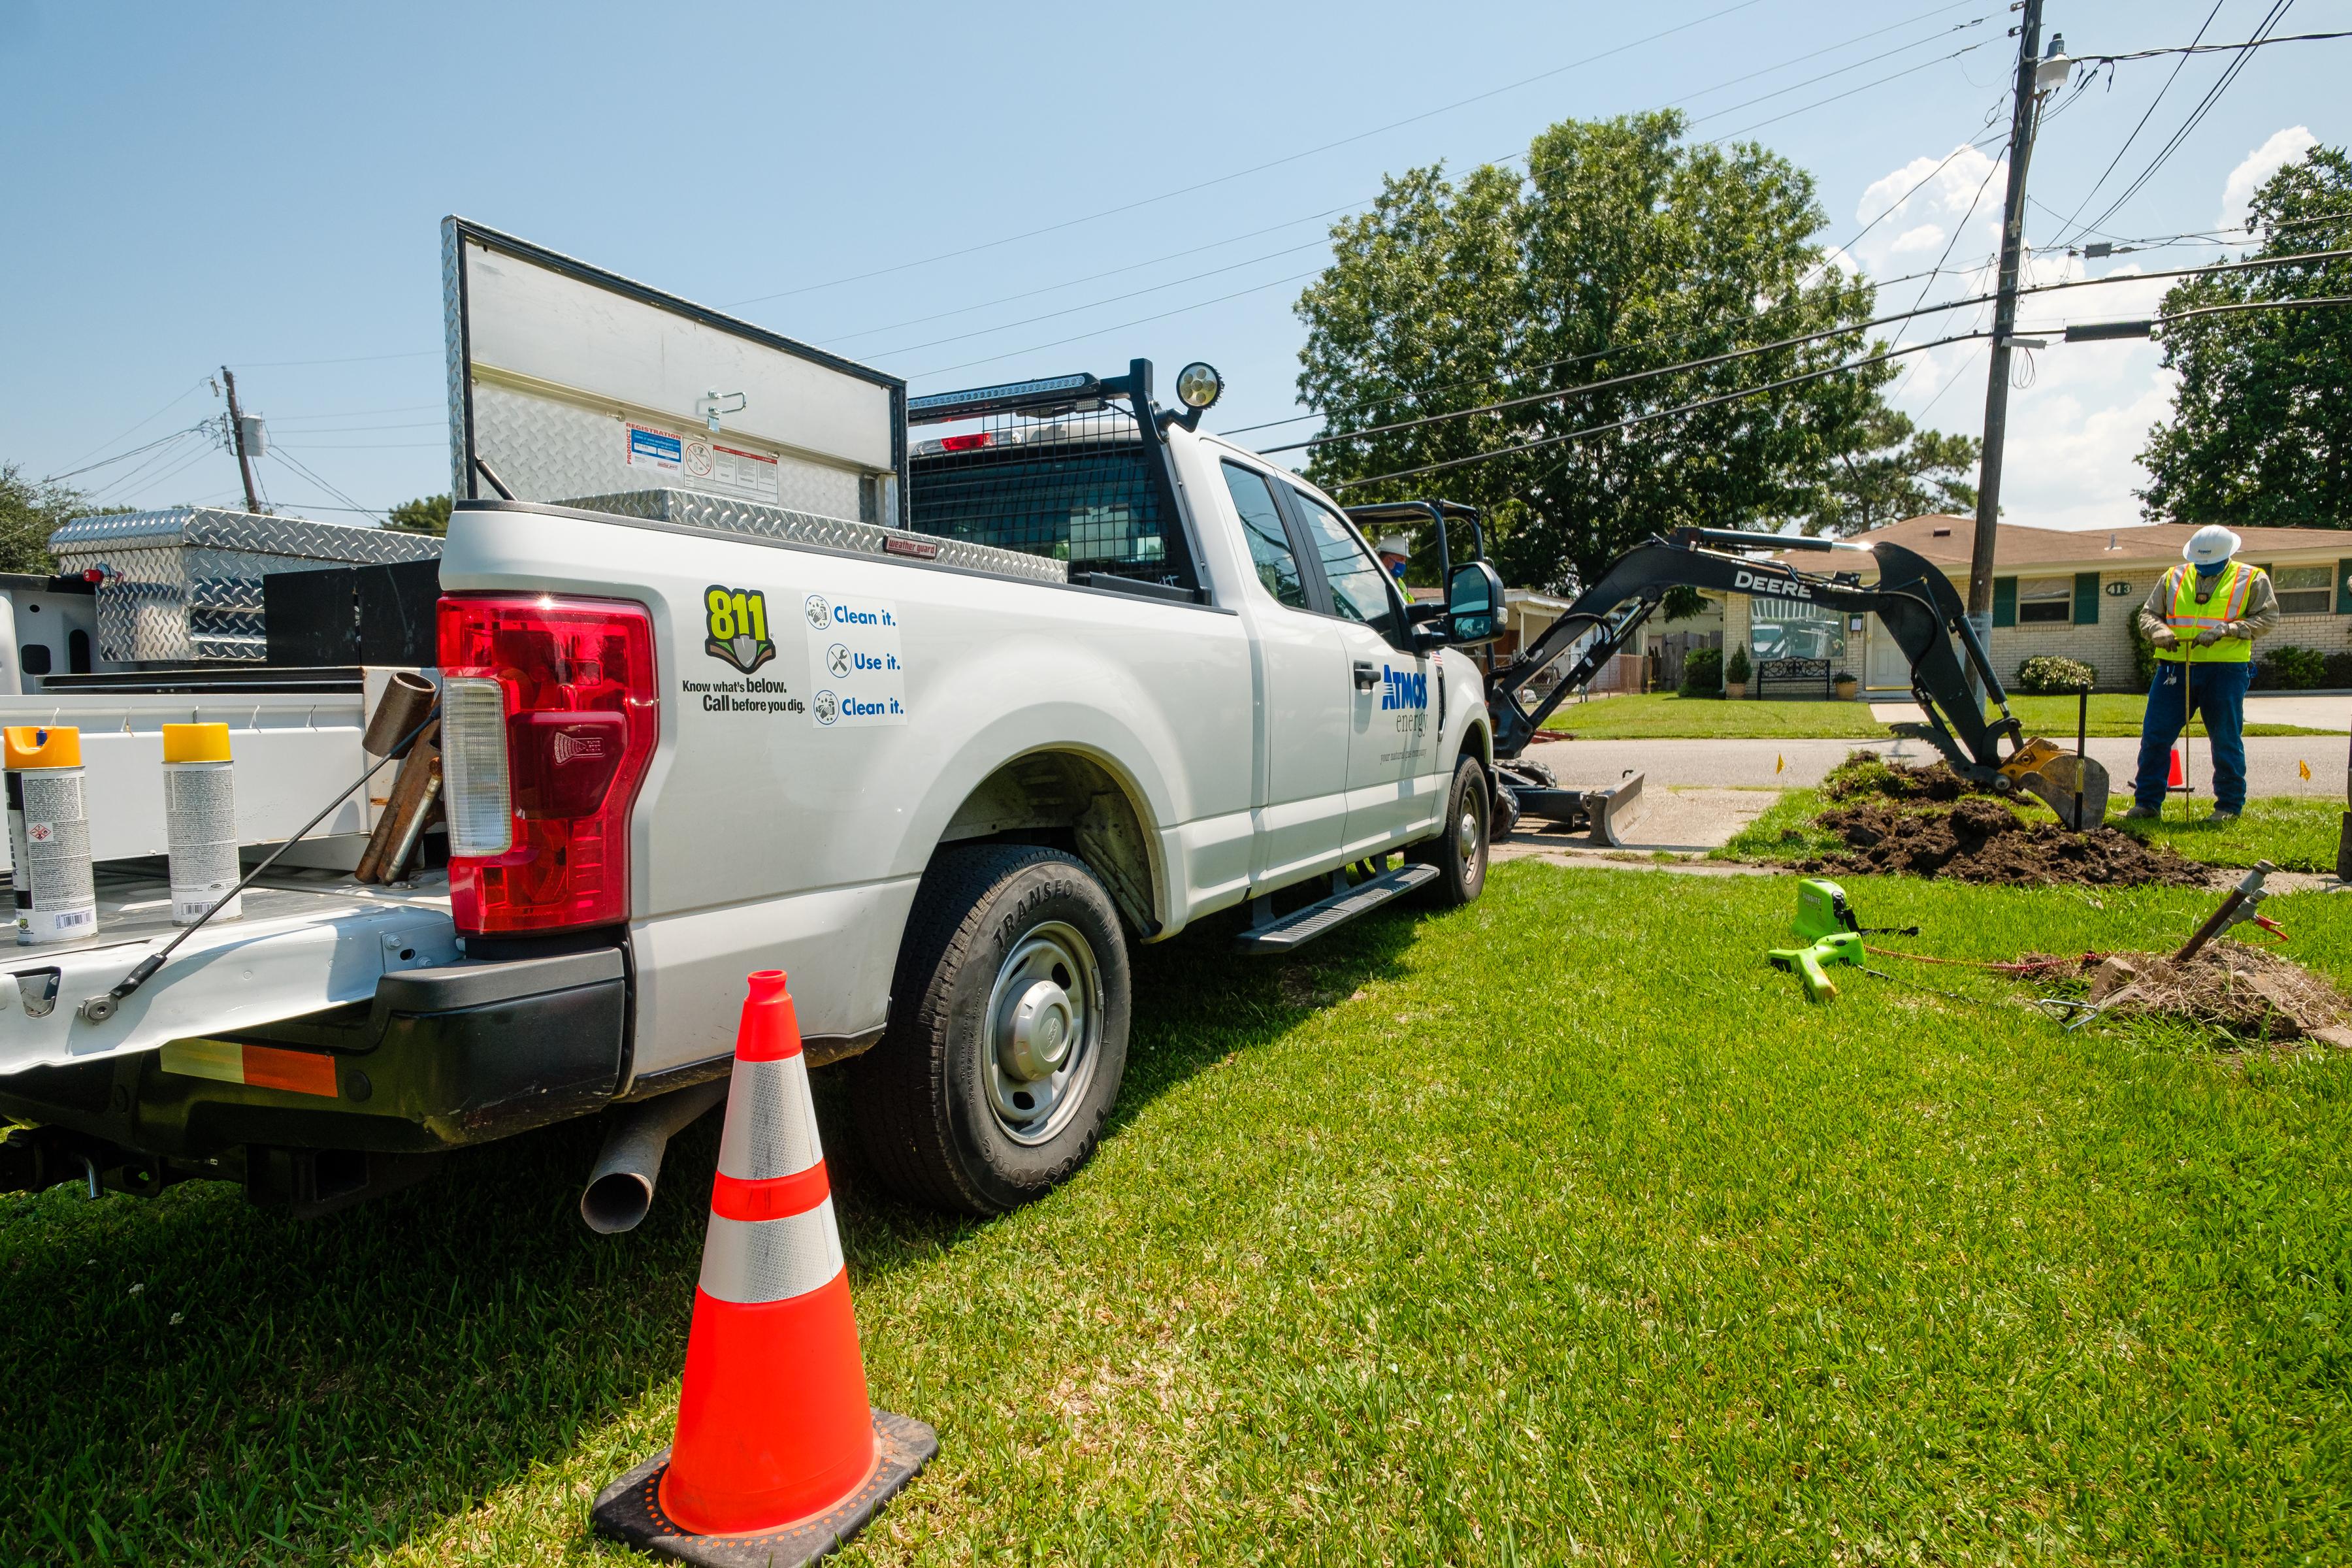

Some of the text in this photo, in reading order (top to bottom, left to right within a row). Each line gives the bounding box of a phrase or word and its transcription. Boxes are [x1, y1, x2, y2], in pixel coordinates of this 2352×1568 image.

[627, 422, 681, 440] REGISTRATION
[889, 540, 935, 553] weather guard
[1734, 570, 1812, 599] DEERE
[2108, 585, 2131, 594] 413
[708, 590, 766, 641] 811
[834, 605, 896, 627] Clean it.
[854, 653, 900, 670] Use it.
[682, 678, 787, 693] Know what's below.
[1382, 664, 1427, 710] ATMOS
[703, 694, 806, 714] Call before you dig.
[842, 697, 904, 715] Clean it.
[1396, 712, 1428, 737] energy
[991, 878, 1102, 953] TRANSFORCE
